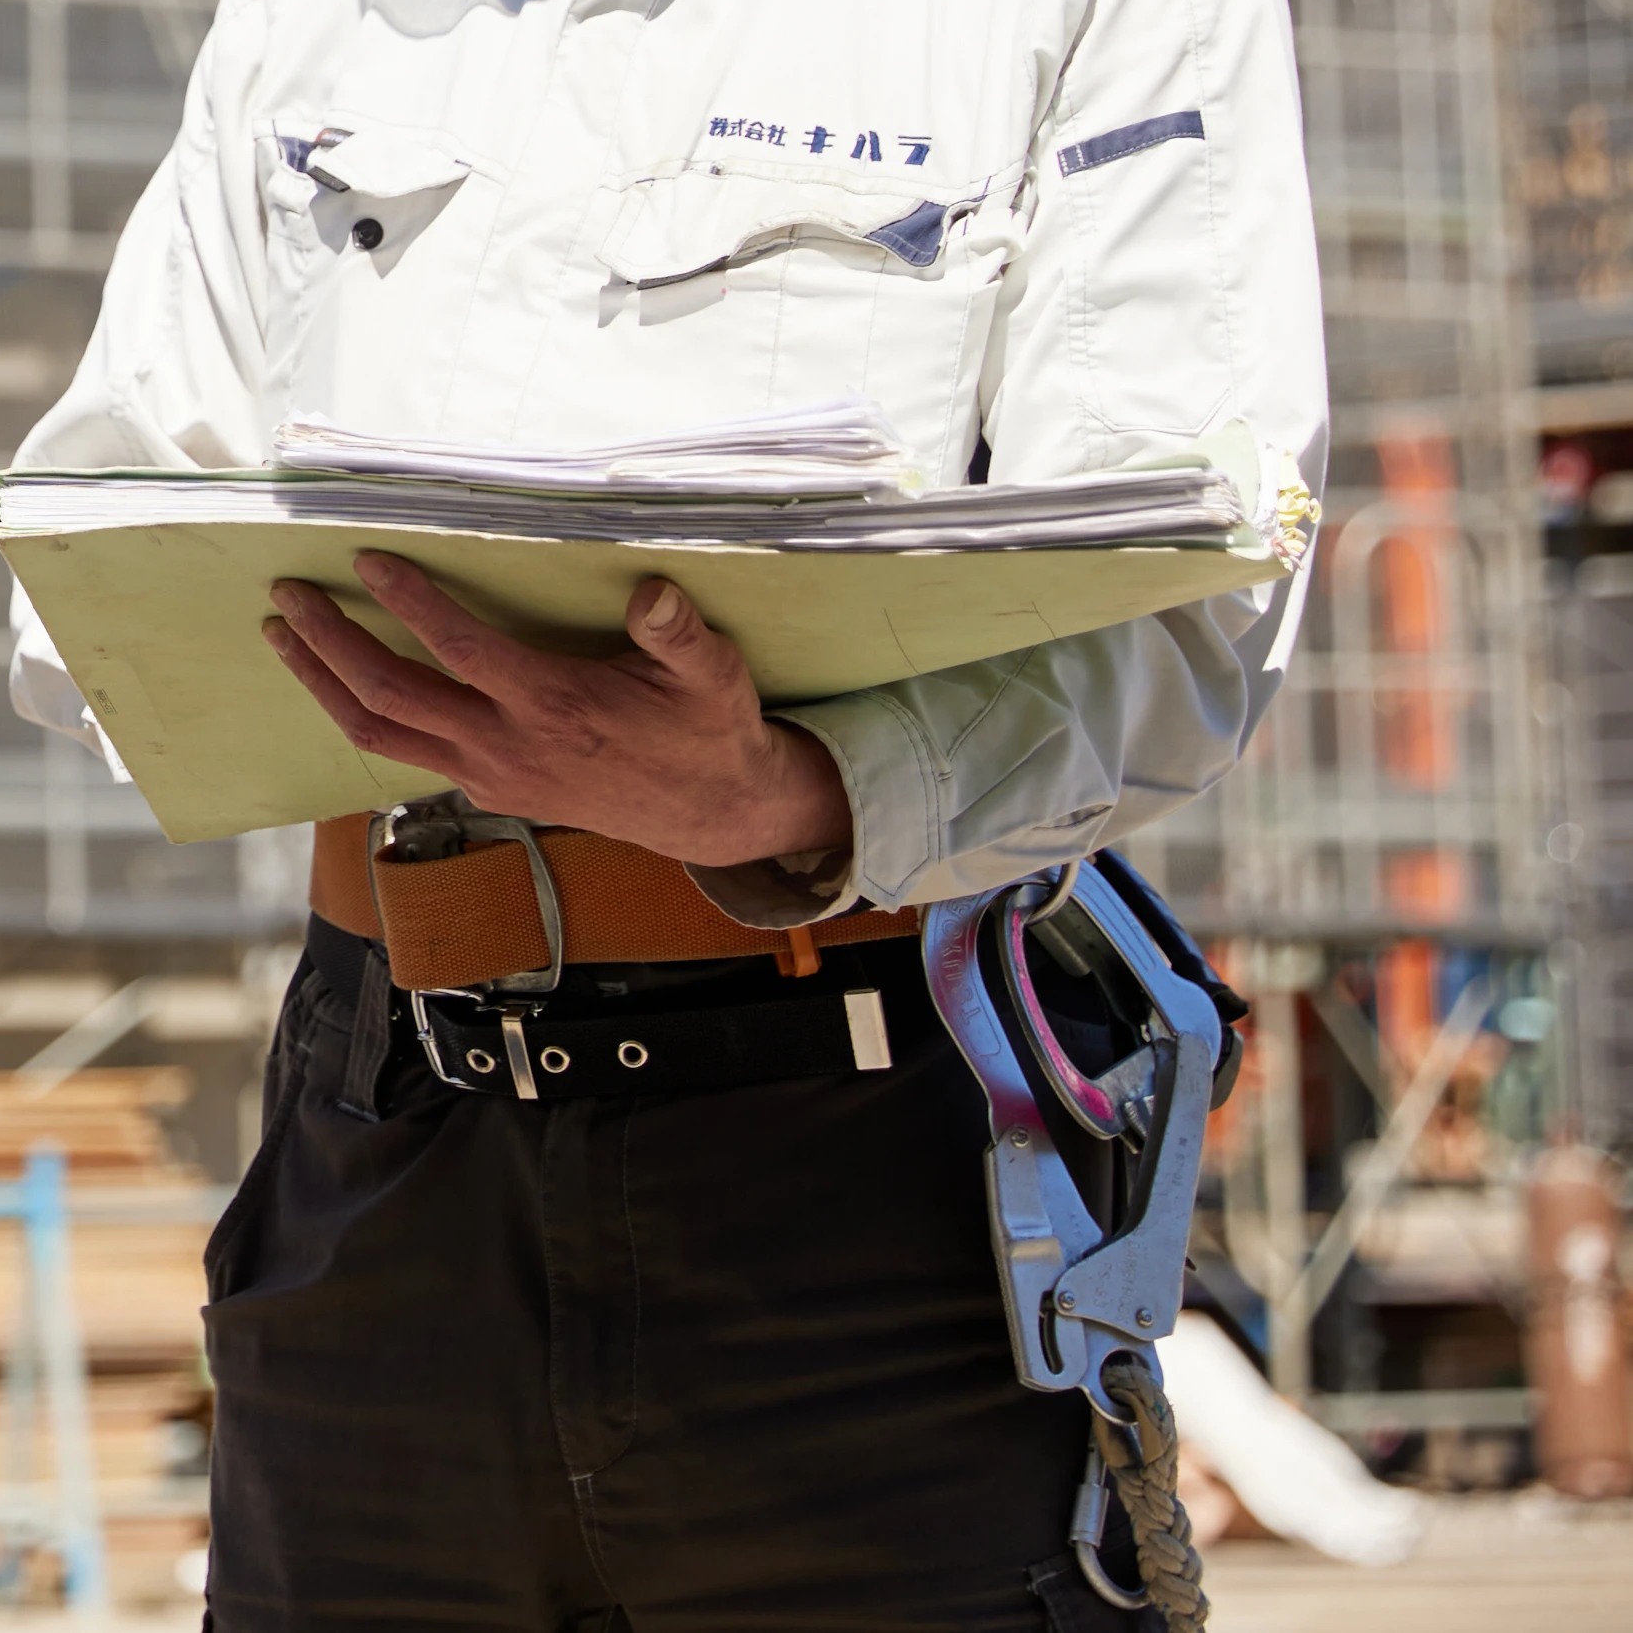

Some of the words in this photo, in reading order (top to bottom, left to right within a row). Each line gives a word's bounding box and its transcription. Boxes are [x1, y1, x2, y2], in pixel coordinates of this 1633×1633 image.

[709, 117, 787, 146] 株式会社
[802, 125, 932, 166] キハラ
